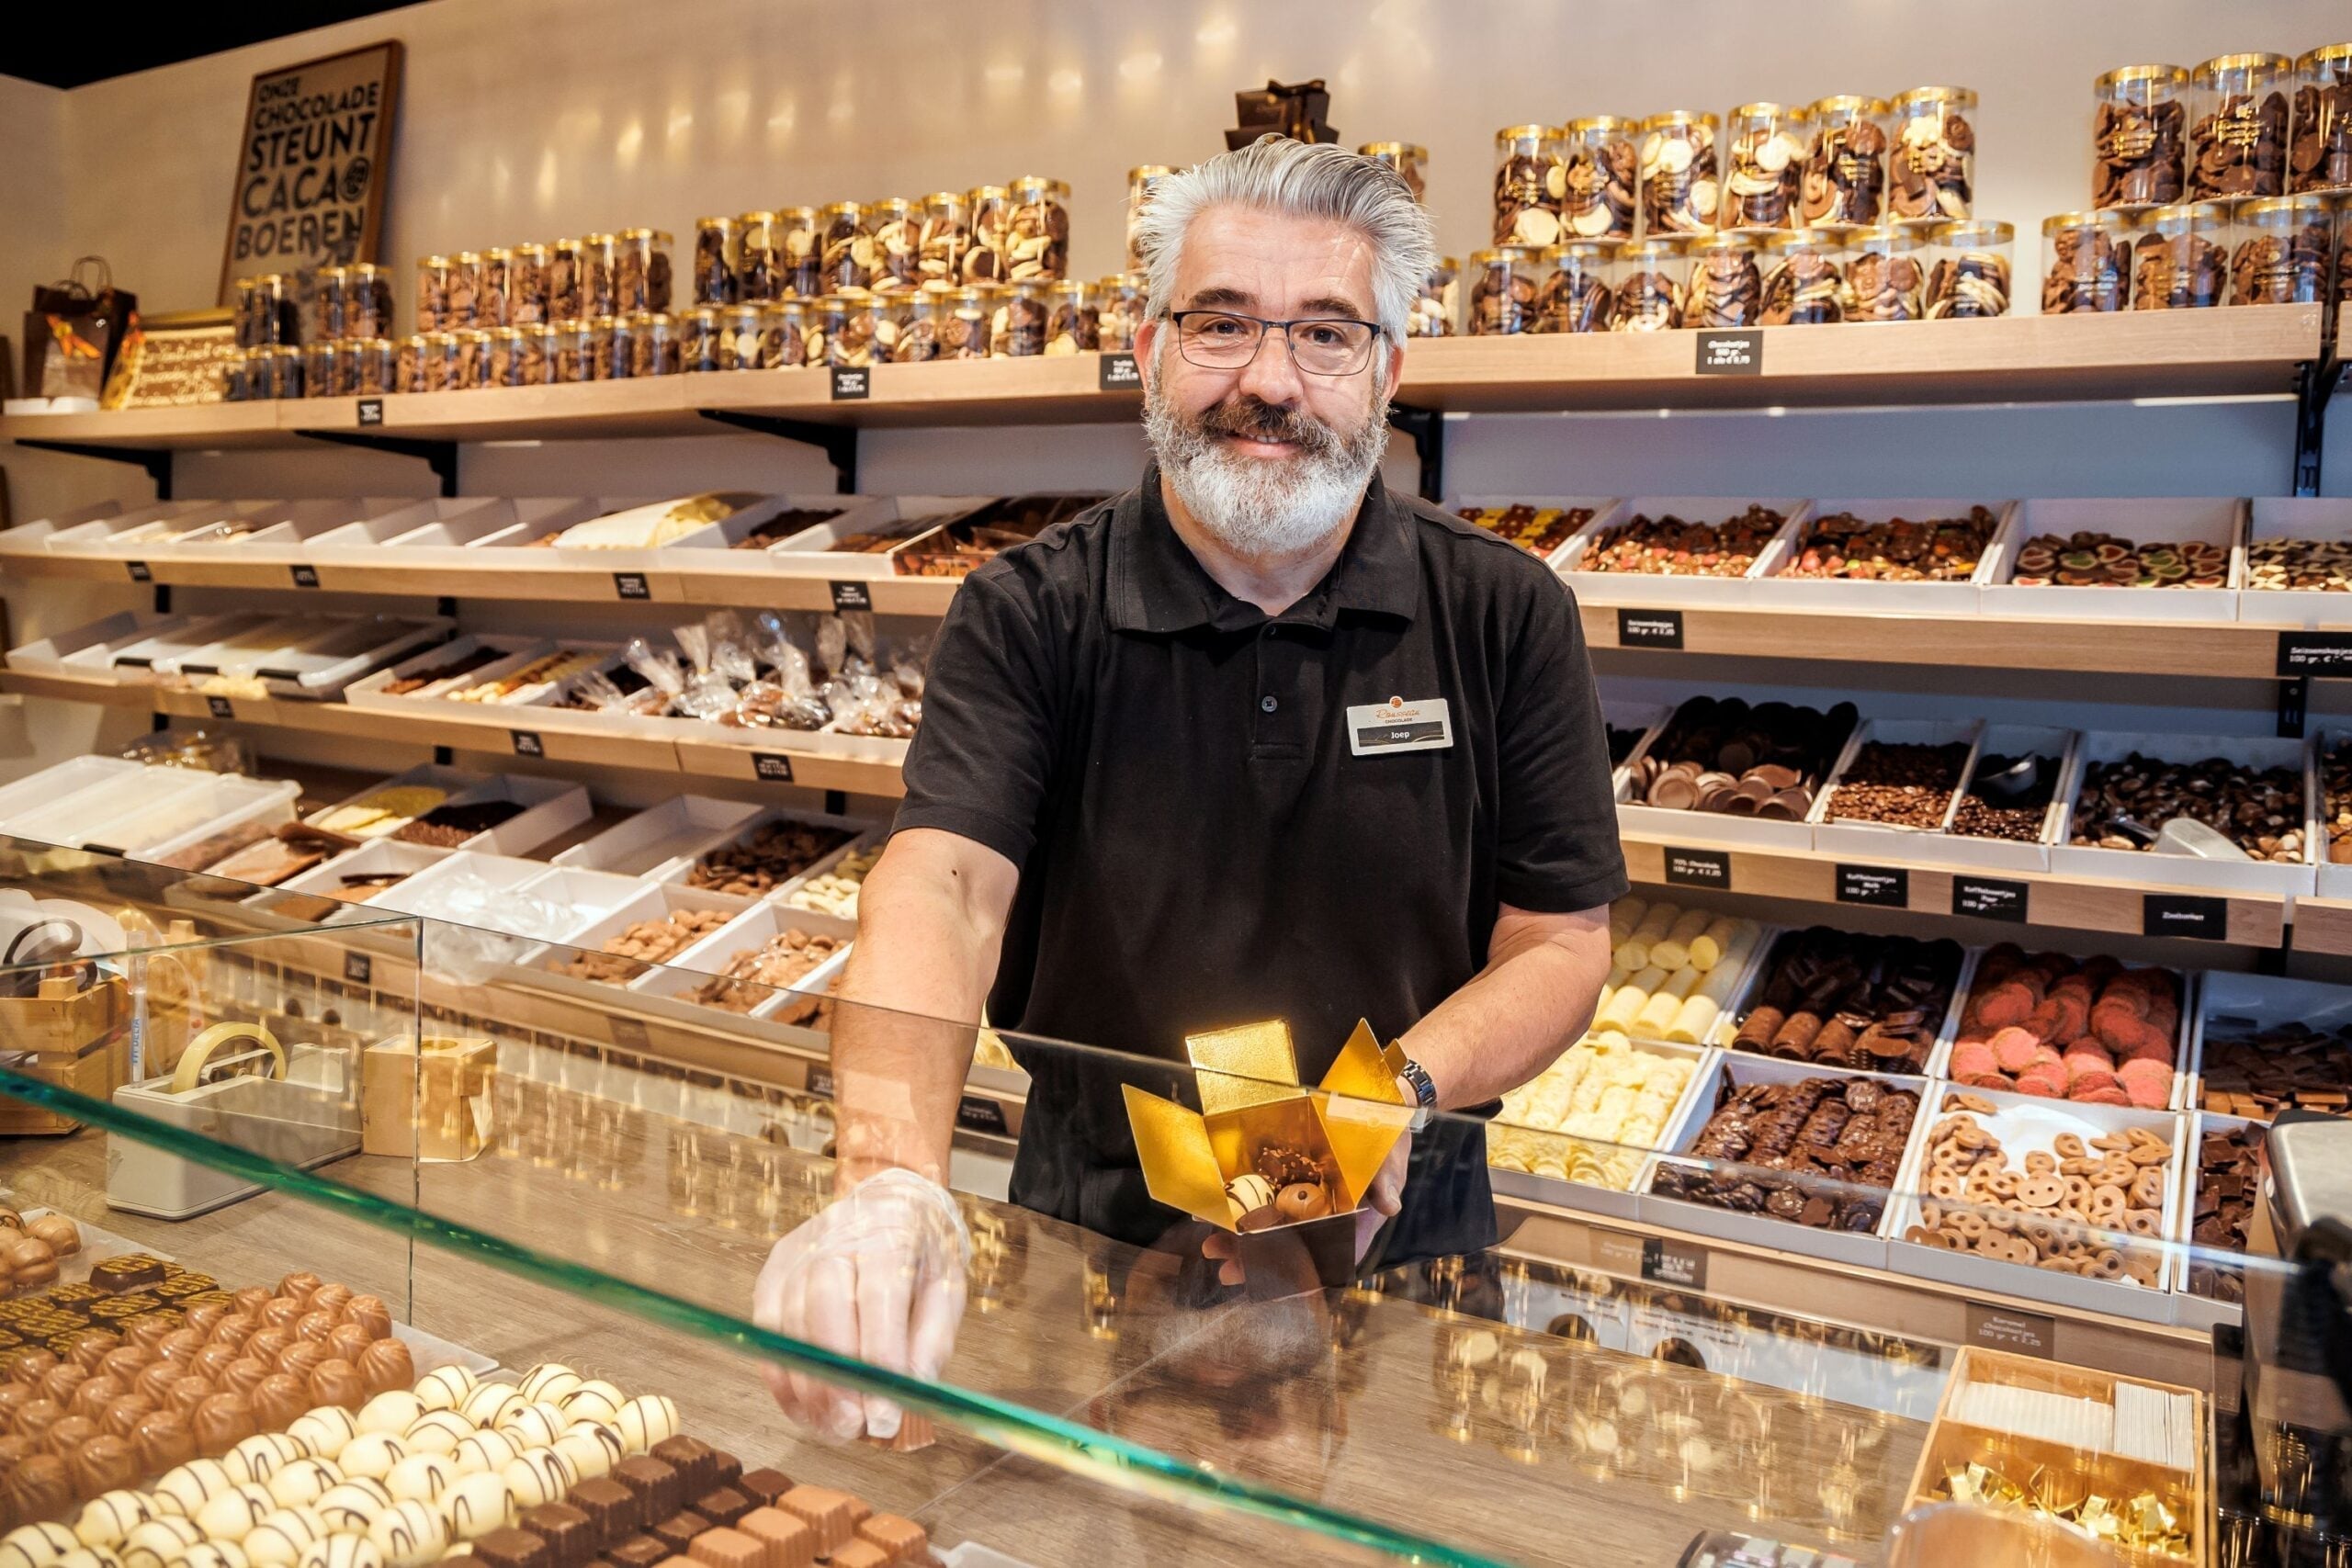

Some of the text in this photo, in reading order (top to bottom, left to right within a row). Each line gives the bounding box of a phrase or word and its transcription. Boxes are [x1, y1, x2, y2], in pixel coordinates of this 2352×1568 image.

[254, 82, 379, 130] CHOCOLADE
[248, 112, 376, 172] STEUNT
[234, 206, 364, 261] BOEREN
[1391, 731, 1410, 739] Joep
[1978, 1328, 1995, 1337] 100
